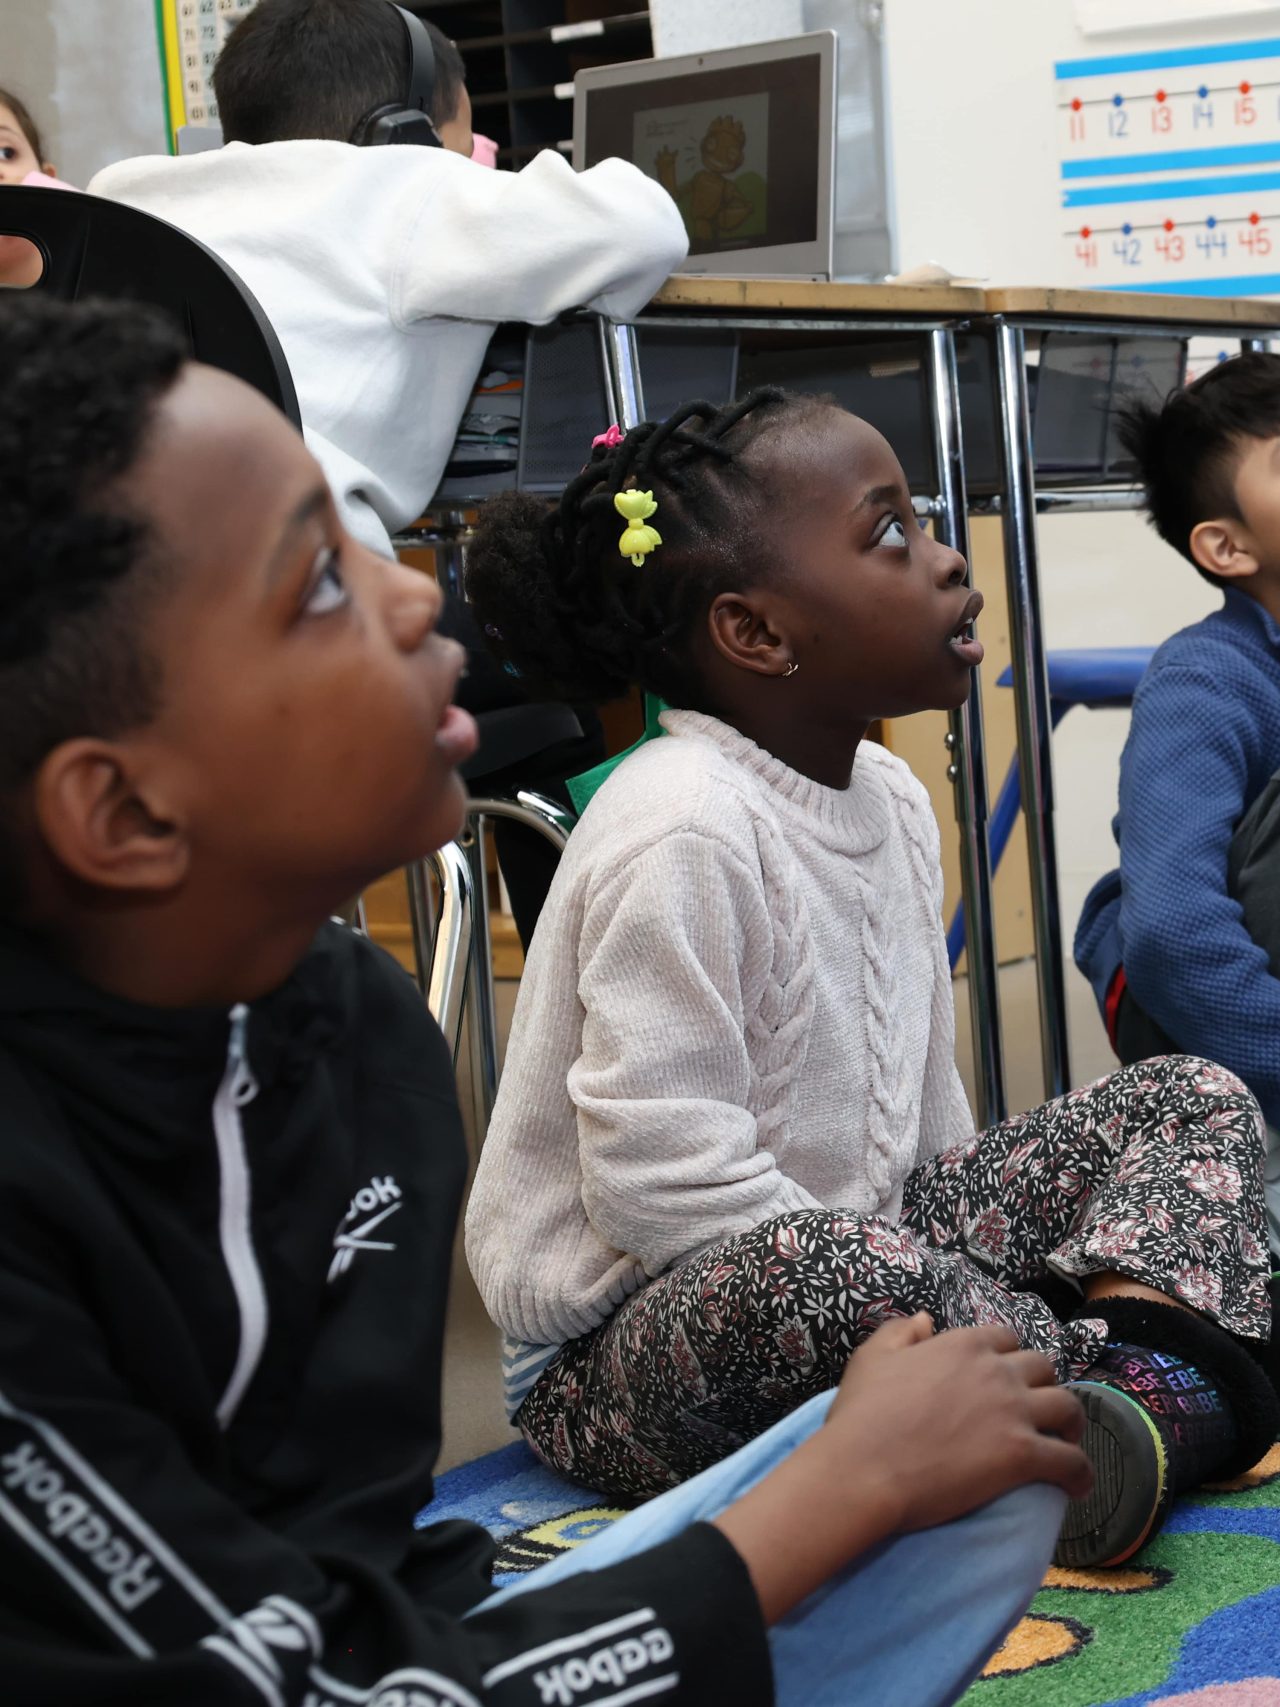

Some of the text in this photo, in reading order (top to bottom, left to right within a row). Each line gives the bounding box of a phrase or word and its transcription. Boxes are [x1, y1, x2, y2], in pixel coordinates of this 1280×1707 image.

[1071, 117, 1084, 140] 11
[1109, 107, 1128, 138] 12
[1152, 103, 1172, 133] 13
[1193, 104, 1213, 128] 14
[1235, 95, 1256, 125] 15
[1076, 245, 1097, 267] 41
[1114, 238, 1141, 266] 42
[1155, 236, 1185, 262] 43
[1196, 234, 1227, 258] 44
[1238, 226, 1271, 256] 45
[1, 1441, 162, 1612] Reebok
[532, 1628, 674, 1706] eebok
